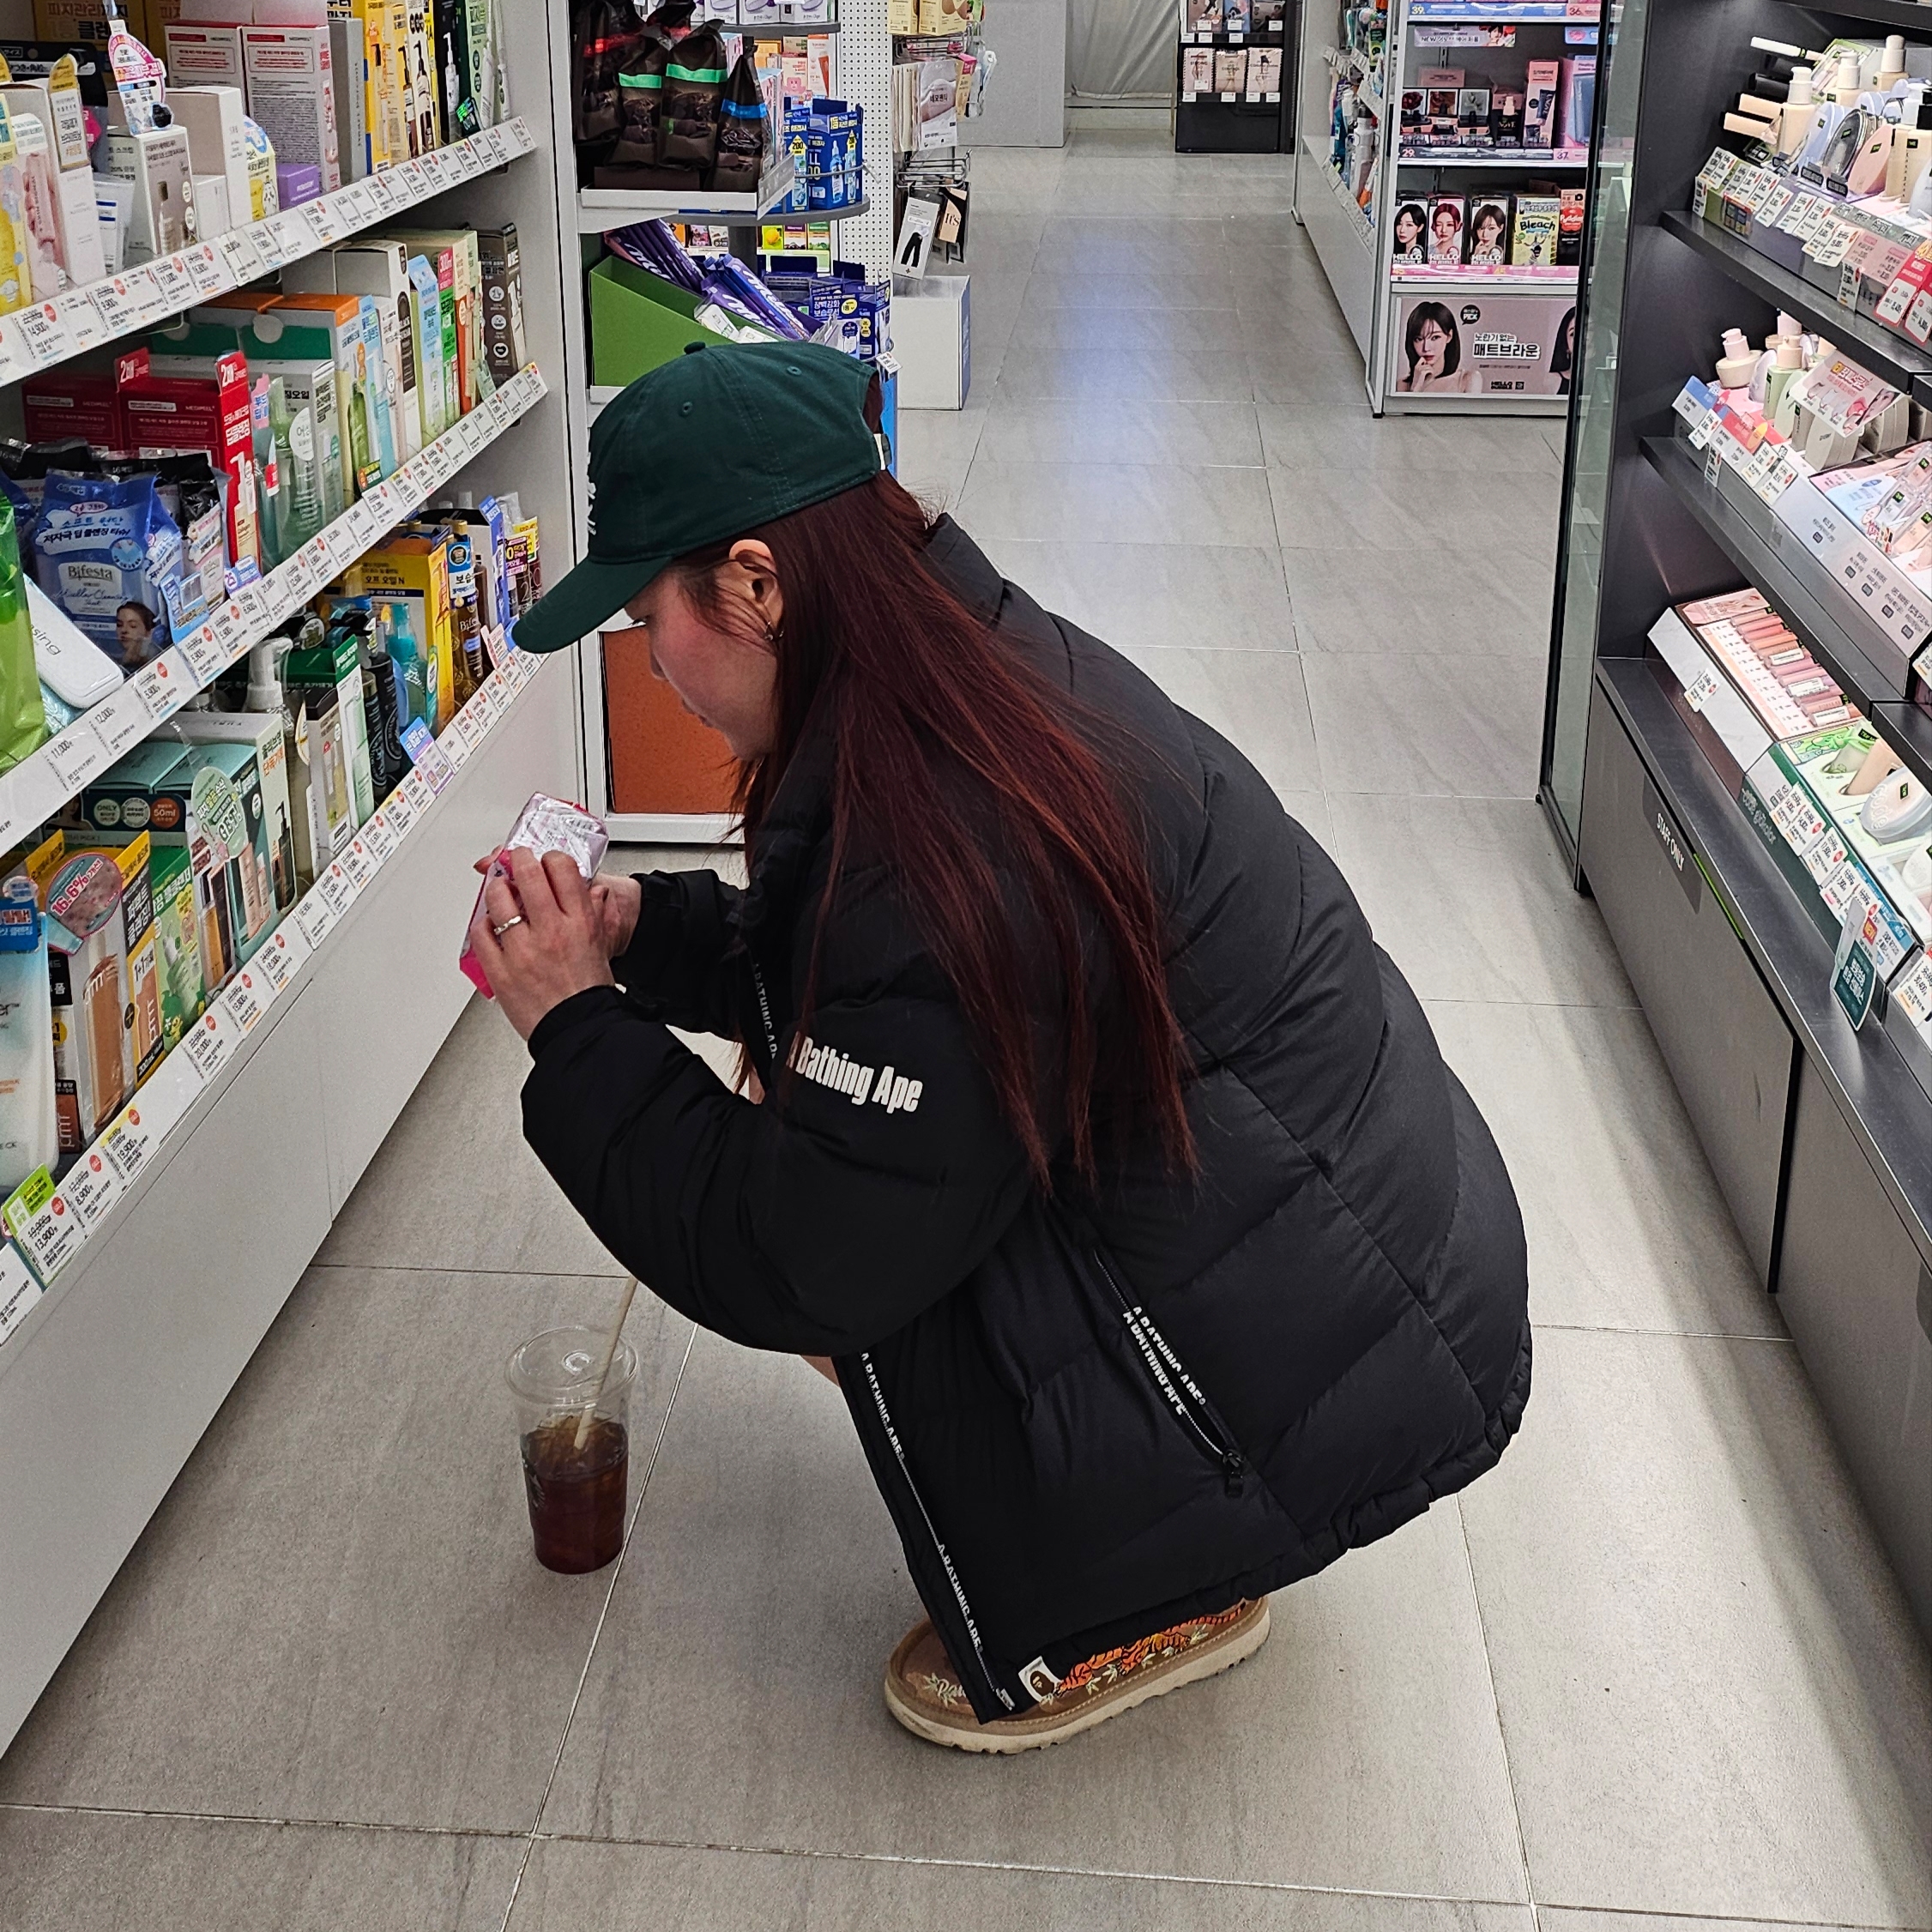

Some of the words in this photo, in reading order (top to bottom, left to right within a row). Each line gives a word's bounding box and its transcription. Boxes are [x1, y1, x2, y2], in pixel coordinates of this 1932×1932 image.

[1519, 220, 1555, 232] Bleach
[1475, 333, 1498, 342] 노란기
[1500, 333, 1515, 342] 없는
[1474, 343, 1538, 357] 매트브라운
[69, 566, 112, 583] Bifesta
[1670, 838, 1684, 871] ONLY
[794, 1035, 874, 1106] Bathing
[871, 1066, 923, 1114] Ape
